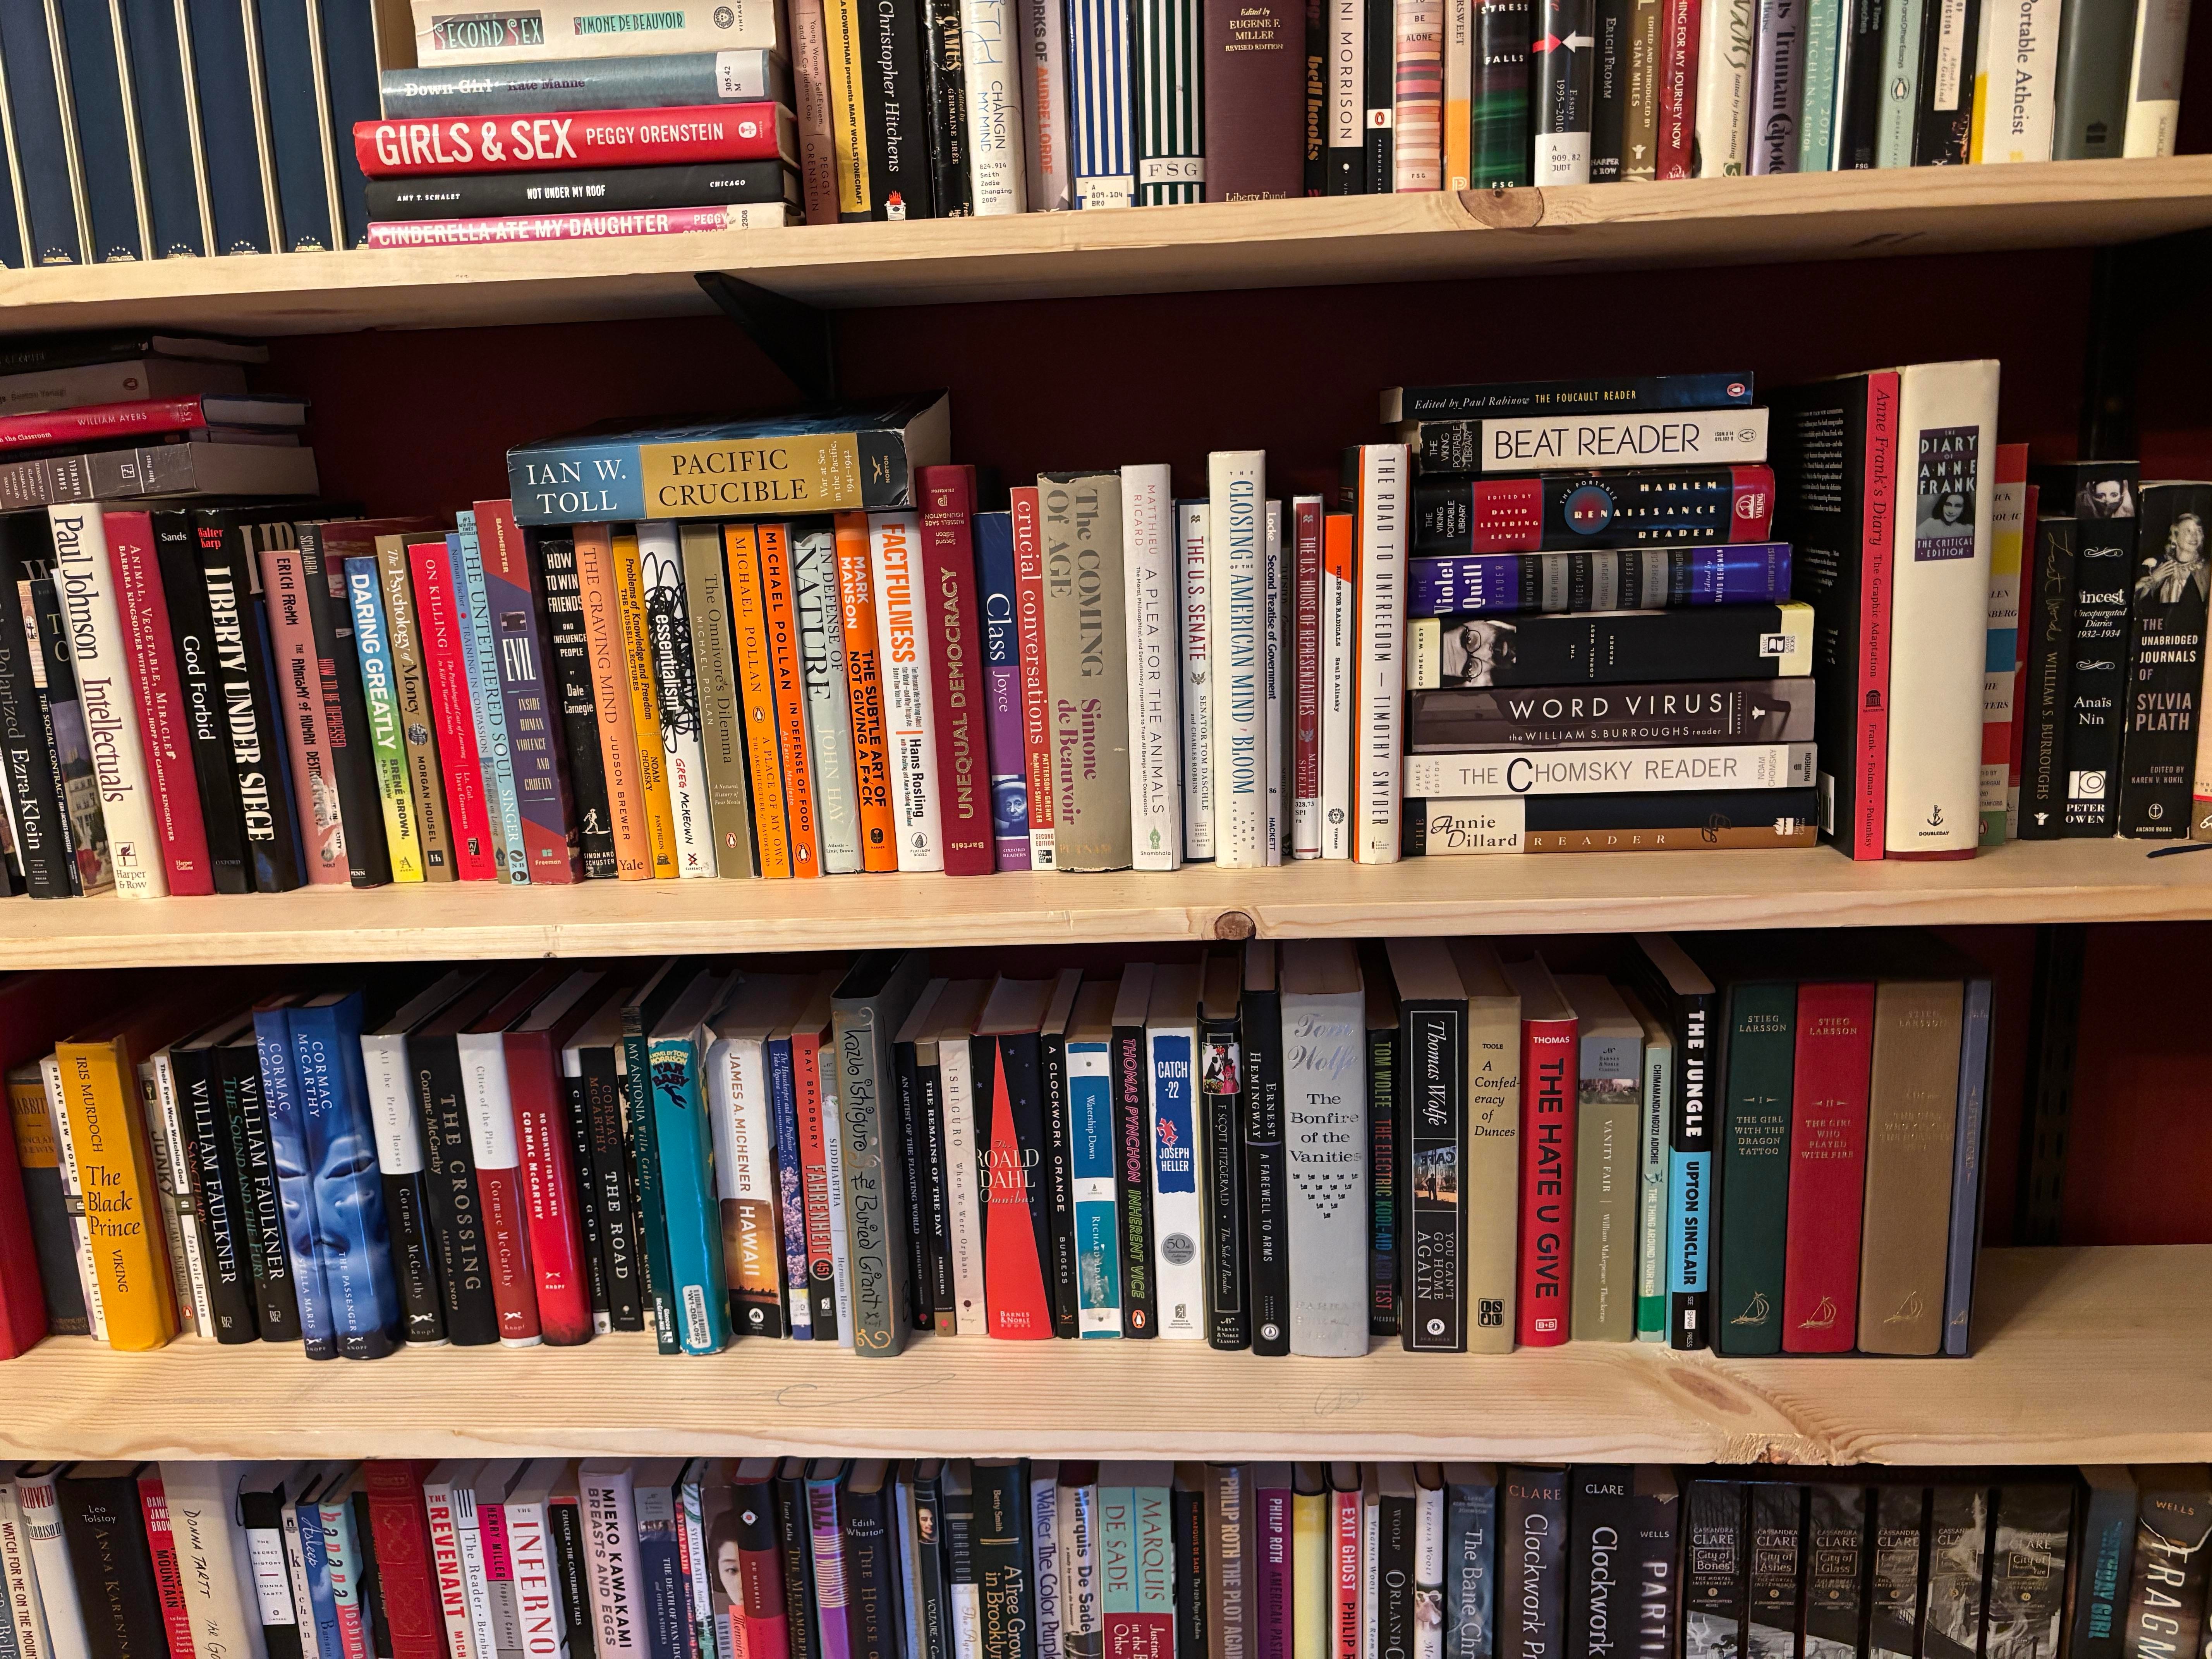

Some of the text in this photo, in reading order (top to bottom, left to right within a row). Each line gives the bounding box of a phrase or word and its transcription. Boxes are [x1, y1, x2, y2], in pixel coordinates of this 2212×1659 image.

[1230, 19, 1271, 29] EUGENE
[1235, 30, 1274, 40] MILLER
[877, 1, 902, 173] Christopher Hitchens
[1340, 32, 1352, 139] MORRISON
[1308, 56, 1322, 161] bell hooks
[2013, 70, 2035, 135] Atheist
[1037, 67, 1053, 175] AUDRE LORDE
[376, 119, 577, 166] GIRLS & SEX
[587, 124, 723, 146] PEGGY ORENSTEIN
[527, 184, 606, 200] NOT UNDER MY ROOF
[710, 179, 745, 188] CHICAGO
[379, 215, 668, 246] CINDERELLA ATE MY DAUGHTER
[1535, 390, 1636, 403] THE FOUCAULT READER
[77, 413, 146, 426] WILLIAM AYERS
[1495, 424, 1700, 460] BEAT READER
[1921, 434, 1977, 455] DIARY
[527, 459, 626, 486] IAN W.
[672, 449, 788, 476] PACIFIC
[57, 468, 67, 491] SARAH
[68, 460, 81, 495] BAKEWELL
[1640, 481, 1716, 492] HARLEM
[1920, 477, 1975, 495] FRANK
[537, 490, 617, 514] TOLL
[659, 479, 808, 507] CRUCIBLE
[1229, 481, 1254, 560] CLOSING
[1575, 505, 1716, 519] RENAISSANCE
[495, 517, 508, 574] BAUMEISTER
[1638, 528, 1714, 539] READER
[54, 516, 99, 660] Paul Johnson
[882, 524, 915, 663] FACTFULNESS
[2081, 589, 2124, 605] incest
[765, 532, 792, 691] MICHAEL POLLAN
[1017, 501, 1047, 745] crucial conversations
[986, 592, 1012, 661] Class
[2142, 634, 2198, 646] UNABRIDGED
[351, 574, 397, 750] DARING GREATLY
[503, 637, 536, 682] EVIL
[655, 613, 679, 711] essentialism
[1230, 574, 1254, 723] AMERICAN MIND
[2139, 651, 2196, 664] JOURNALS
[183, 635, 216, 740] God Forbid
[941, 567, 974, 819] UNEQUAL DEMOCRACY
[993, 672, 1010, 713] Joyce
[204, 567, 275, 842] LIBERTY UNDER SIEGE
[1509, 694, 1721, 720] WORD VIRUS
[2074, 696, 2112, 709] Anaïs
[2137, 692, 2192, 711] SYLVIA
[2079, 713, 2104, 725] Nin
[2136, 712, 2190, 731] PLATH
[83, 677, 133, 802] Intellectuals
[1525, 729, 1585, 741] WILLIAM
[1591, 730, 1599, 738] S.
[1602, 727, 1689, 738] BURROUGHS
[1232, 737, 1254, 795] BLOOM
[1459, 768, 1498, 784] THE
[1645, 758, 1737, 779] READER
[417, 756, 436, 842] MORGAN HOUSEL
[2066, 804, 2104, 812] PETER
[1430, 816, 1496, 833] Annie
[2066, 815, 2104, 824] OWEN
[1267, 817, 1276, 852] HACKETT
[1447, 828, 1517, 848] Dillard
[619, 859, 644, 871] Yale
[1158, 1060, 1188, 1079] CATCH
[1685, 1010, 1704, 1137] THE JUNGLE
[1307, 1094, 1341, 1104] The
[1290, 1112, 1359, 1124] Bonfire
[1475, 1125, 1515, 1137] Dunces
[1301, 1132, 1350, 1143] of the
[1159, 1147, 1190, 1159] JOSEPH
[1161, 1160, 1189, 1173] HELLER
[1289, 1150, 1362, 1162] Vanities
[86, 1166, 121, 1187] The
[191, 1079, 236, 1283] WILLIAM FAULKNER
[829, 1138, 840, 1207] SIDDHARTHA
[1536, 1058, 1563, 1298] THE HATE U GIVE
[89, 1192, 132, 1212] Black
[441, 1094, 481, 1290] THE CROSSING
[806, 1165, 832, 1254] FAHRENHEIT
[89, 1216, 140, 1237] Prince
[605, 1171, 627, 1279] THE ROAD
[1683, 1162, 1698, 1285] UPTON SINCLAIR
[738, 1205, 760, 1277] HAWAII
[1059, 1237, 1068, 1284] BURGESS
[1509, 1486, 1561, 1500] CLARE
[1585, 1484, 1624, 1495] CLARE
[83, 1514, 115, 1523] Tolstoy
[89, 1505, 106, 1513] Leo
[2156, 1500, 2195, 1515] WELLS
[847, 1528, 884, 1537] Wharton
[430, 1507, 465, 1618] REVENANT
[1106, 1505, 1128, 1593] DE SADE
[1143, 1498, 1165, 1601] MARQUIS
[1341, 1508, 1355, 1590] EXIT GHOST
[602, 1488, 632, 1648] MIEKO KAWAKAMI
[512, 1522, 555, 1654] INFERNO
[1588, 1527, 1618, 1657] Clockwork
[928, 1599, 938, 1637] VOLTAIRE
